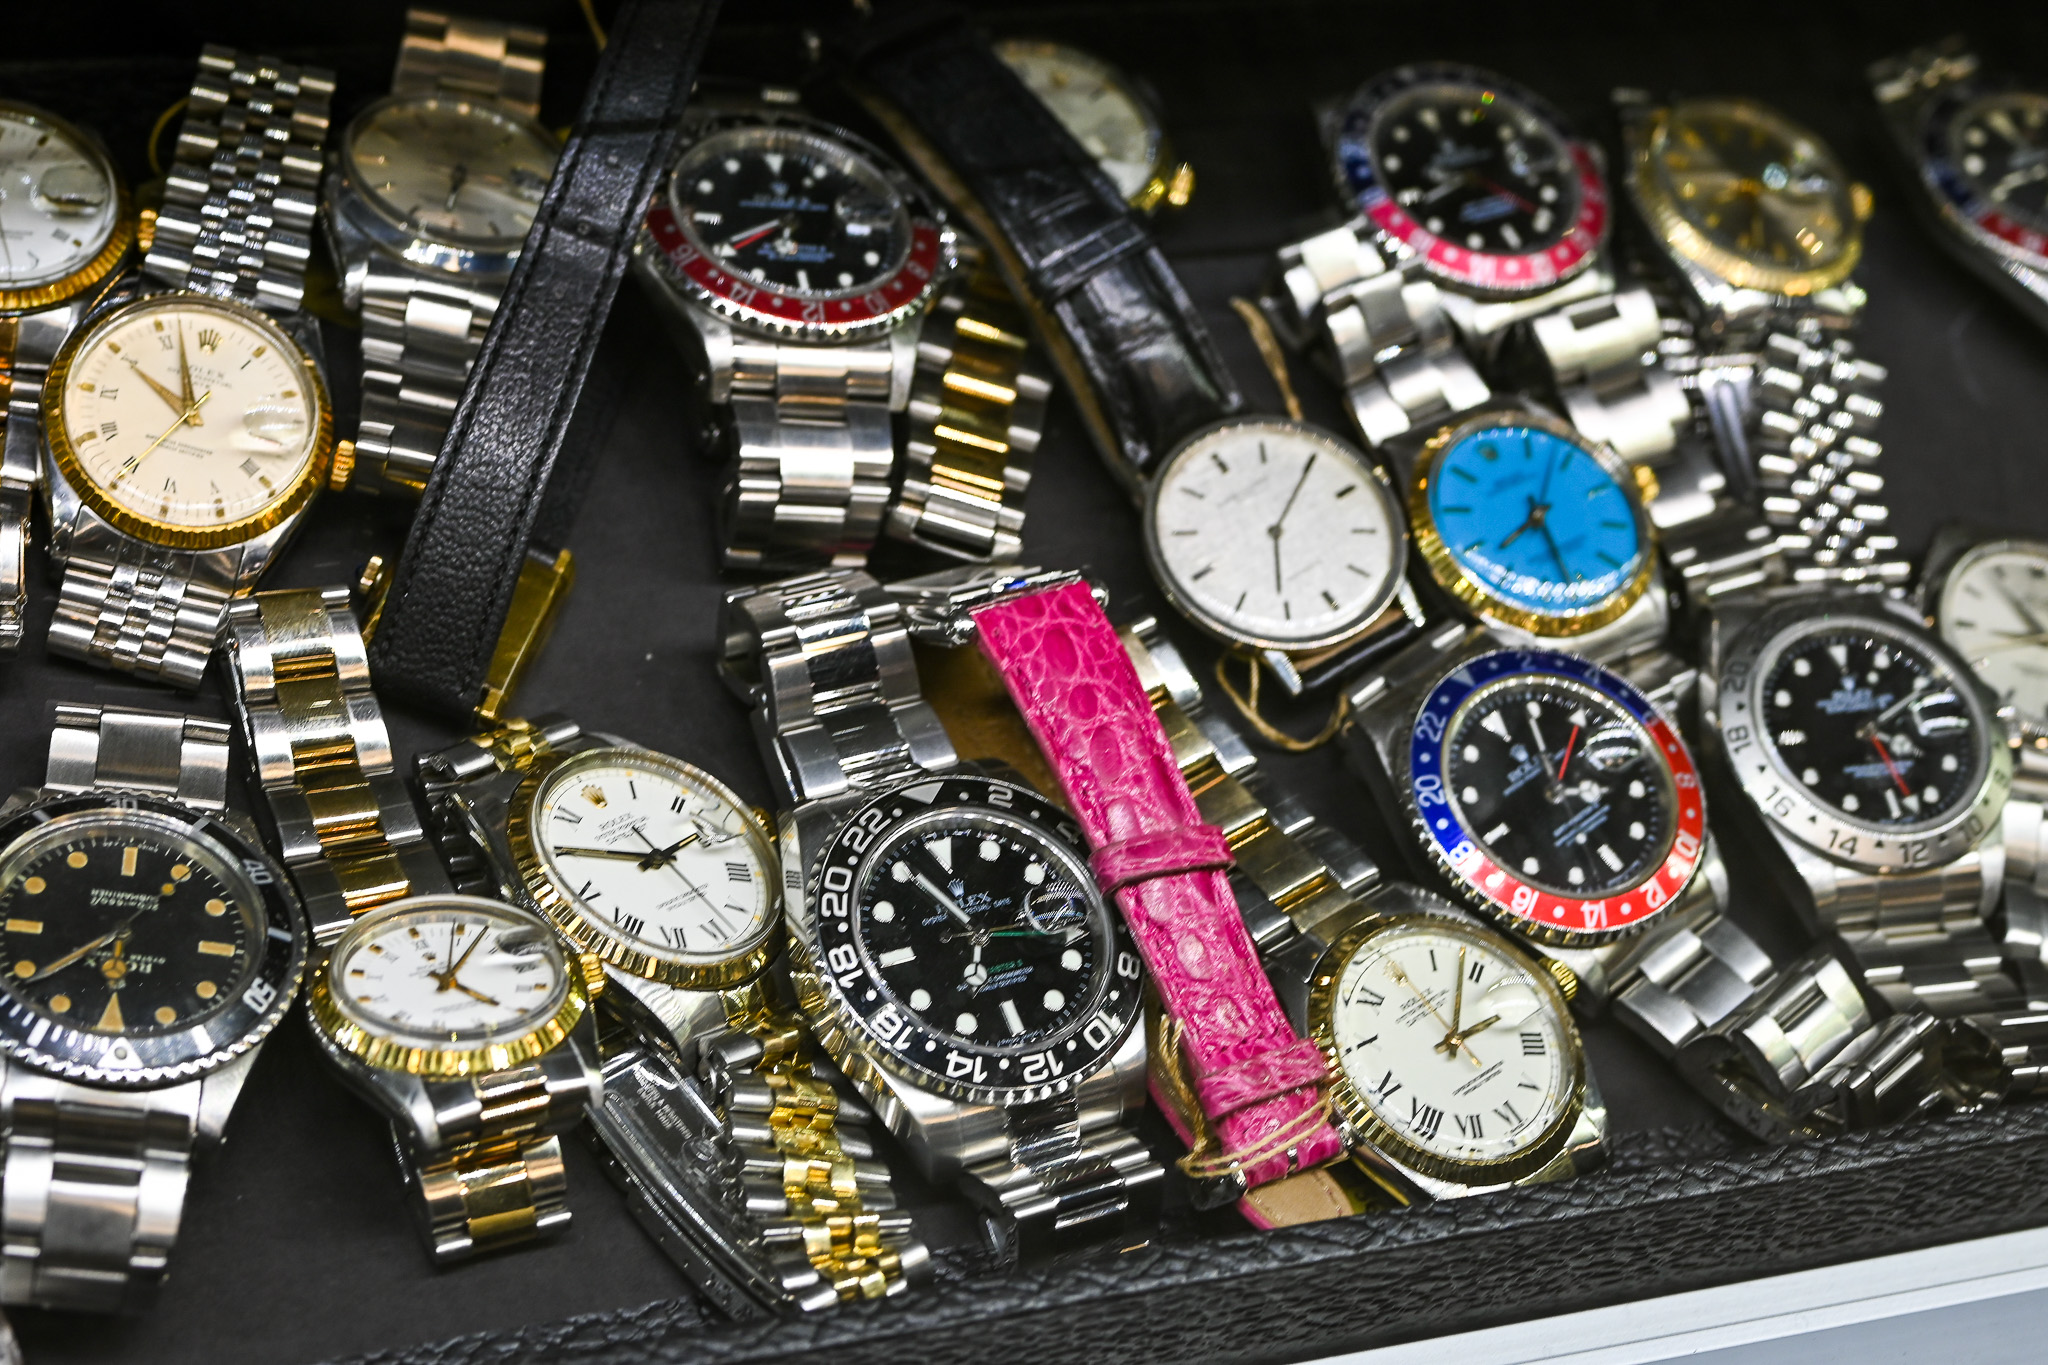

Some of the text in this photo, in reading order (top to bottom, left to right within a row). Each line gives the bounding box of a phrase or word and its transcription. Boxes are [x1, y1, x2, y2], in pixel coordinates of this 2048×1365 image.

[727, 281, 756, 305] 14
[801, 301, 826, 323] 12
[1416, 712, 1447, 743] 22
[1727, 724, 1751, 754] 18
[670, 795, 687, 814] II
[988, 784, 1014, 808] 2
[1415, 775, 1446, 807] 20
[1765, 785, 1796, 818] 16
[842, 807, 884, 859] 22
[1055, 820, 1081, 845] 4
[1827, 829, 1859, 856] 14
[1900, 842, 1931, 863] 12
[243, 858, 273, 886] 40
[725, 861, 752, 882] IIII
[821, 866, 853, 918] 20
[1511, 885, 1540, 917] 16
[1639, 882, 1668, 908] 12
[614, 906, 645, 937] VIII
[1580, 900, 1608, 928] 14
[660, 925, 687, 949] VII
[827, 942, 864, 990] 18
[1117, 951, 1142, 980] 8
[1429, 949, 1438, 972] I
[1468, 961, 1486, 984] II
[243, 977, 278, 1014] 50
[870, 1002, 913, 1050] 16
[1083, 1009, 1127, 1051] 10
[1520, 1031, 1546, 1056] IIII
[945, 1050, 989, 1084] 14
[1020, 1050, 1065, 1084] 12
[1412, 1097, 1445, 1141] VIII
[1454, 1113, 1484, 1139] VII
